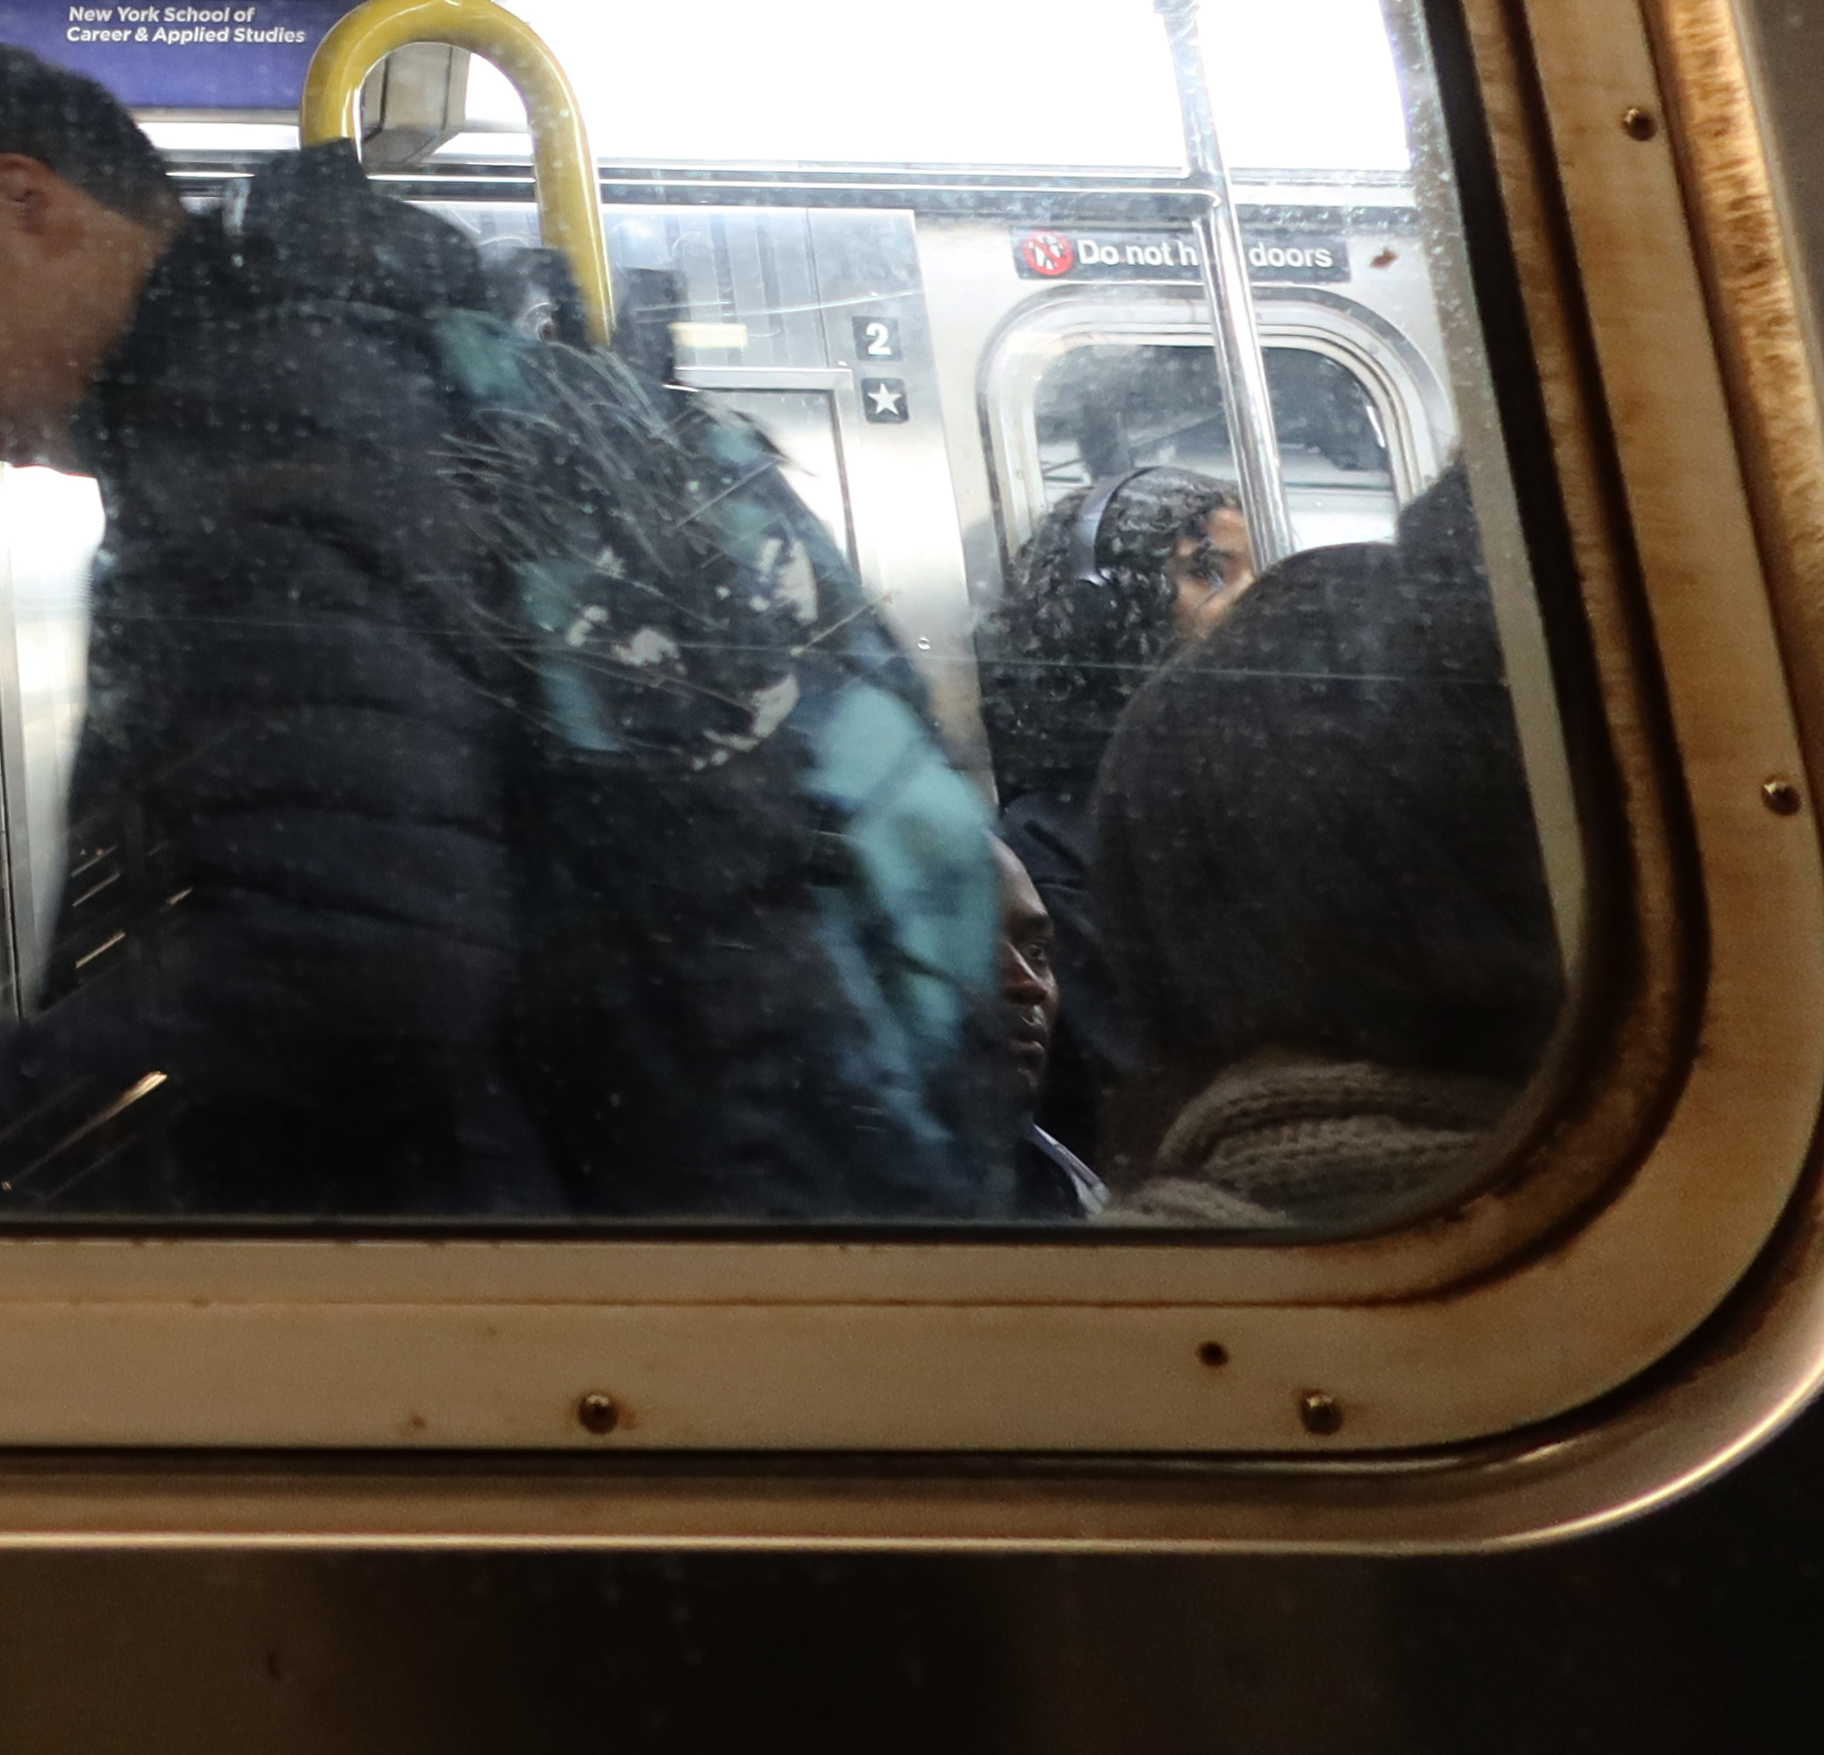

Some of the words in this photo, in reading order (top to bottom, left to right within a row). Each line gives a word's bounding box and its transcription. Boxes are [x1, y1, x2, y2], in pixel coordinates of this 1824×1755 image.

[69, 7, 112, 22] New
[117, 6, 159, 22] York
[164, 7, 229, 23] School
[233, 7, 256, 22] of
[67, 26, 131, 42] Career
[134, 27, 149, 42] &
[152, 26, 230, 45] Applied
[233, 27, 306, 44] Studies
[1077, 240, 1120, 265] Do
[1126, 243, 1175, 266] not
[1249, 242, 1333, 267] doors
[865, 322, 892, 355] 2
